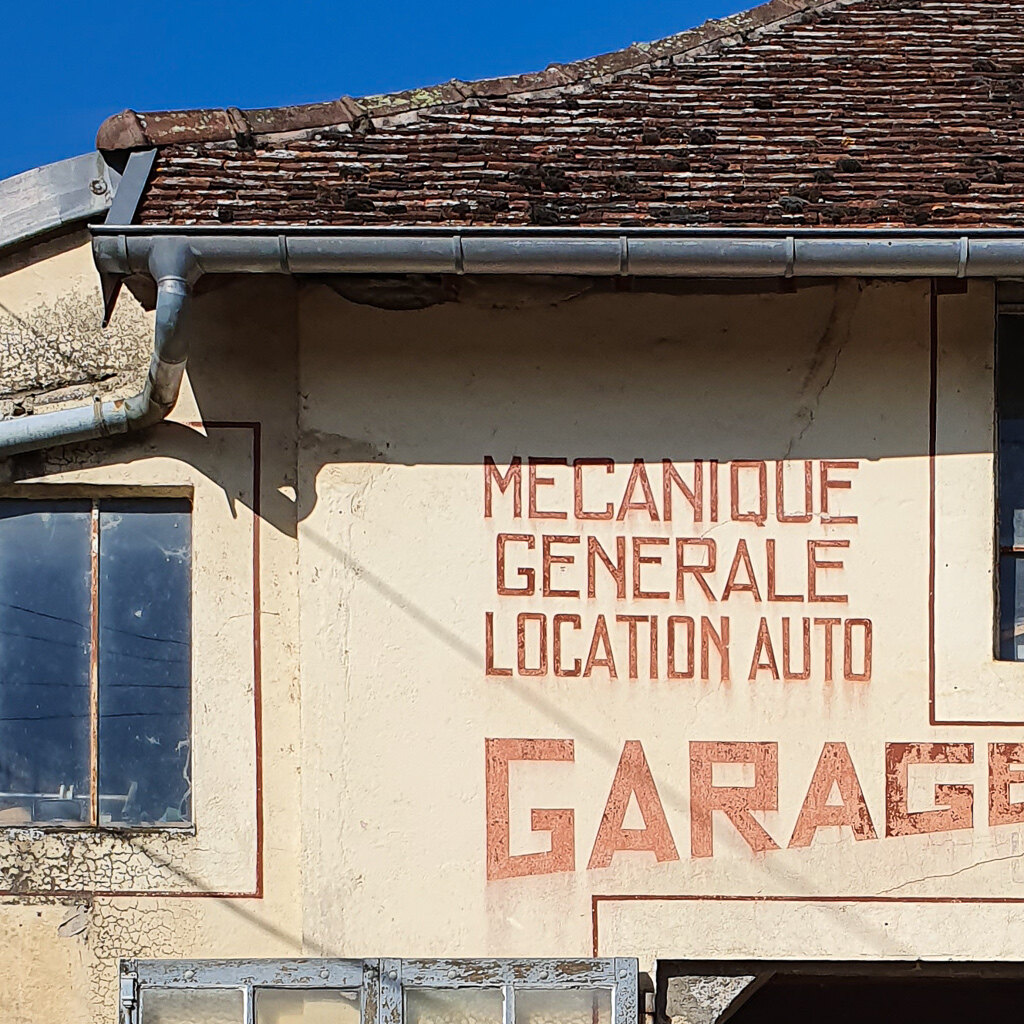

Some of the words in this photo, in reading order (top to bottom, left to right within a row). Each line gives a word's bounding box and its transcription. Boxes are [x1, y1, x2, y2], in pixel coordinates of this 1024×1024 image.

[484, 456, 859, 526] MECANIQUE
[497, 533, 850, 602] GENERALE
[485, 611, 730, 680] LOCATION
[748, 616, 873, 681] AUTO
